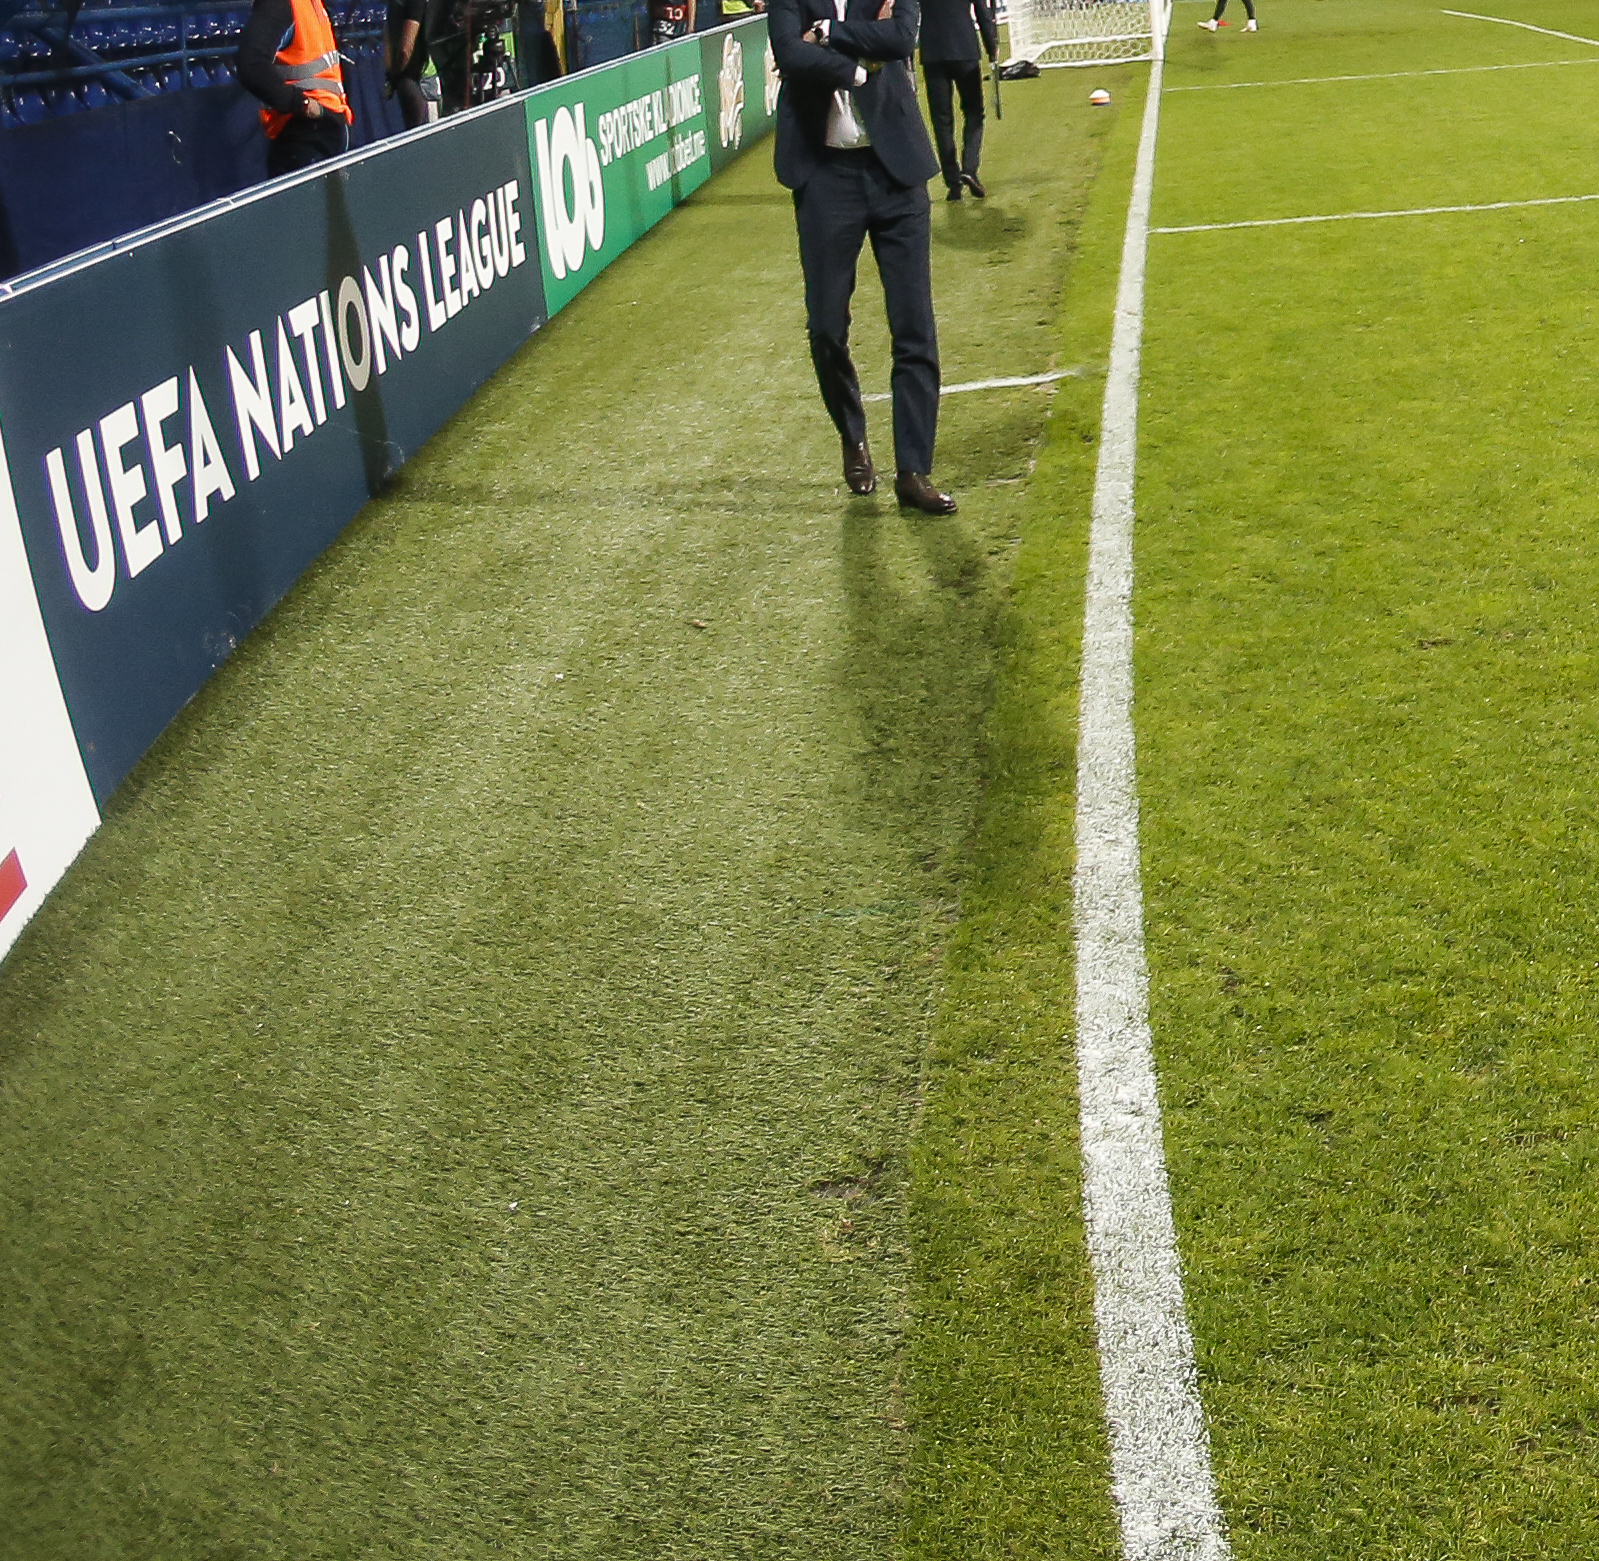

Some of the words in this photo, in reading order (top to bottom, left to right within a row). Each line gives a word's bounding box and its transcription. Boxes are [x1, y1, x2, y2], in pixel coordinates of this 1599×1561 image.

[598, 94, 654, 167] SPORTSKE
[45, 366, 236, 612] UEFA
[226, 244, 420, 482] NATIONS
[417, 179, 526, 333] LEAGUE
